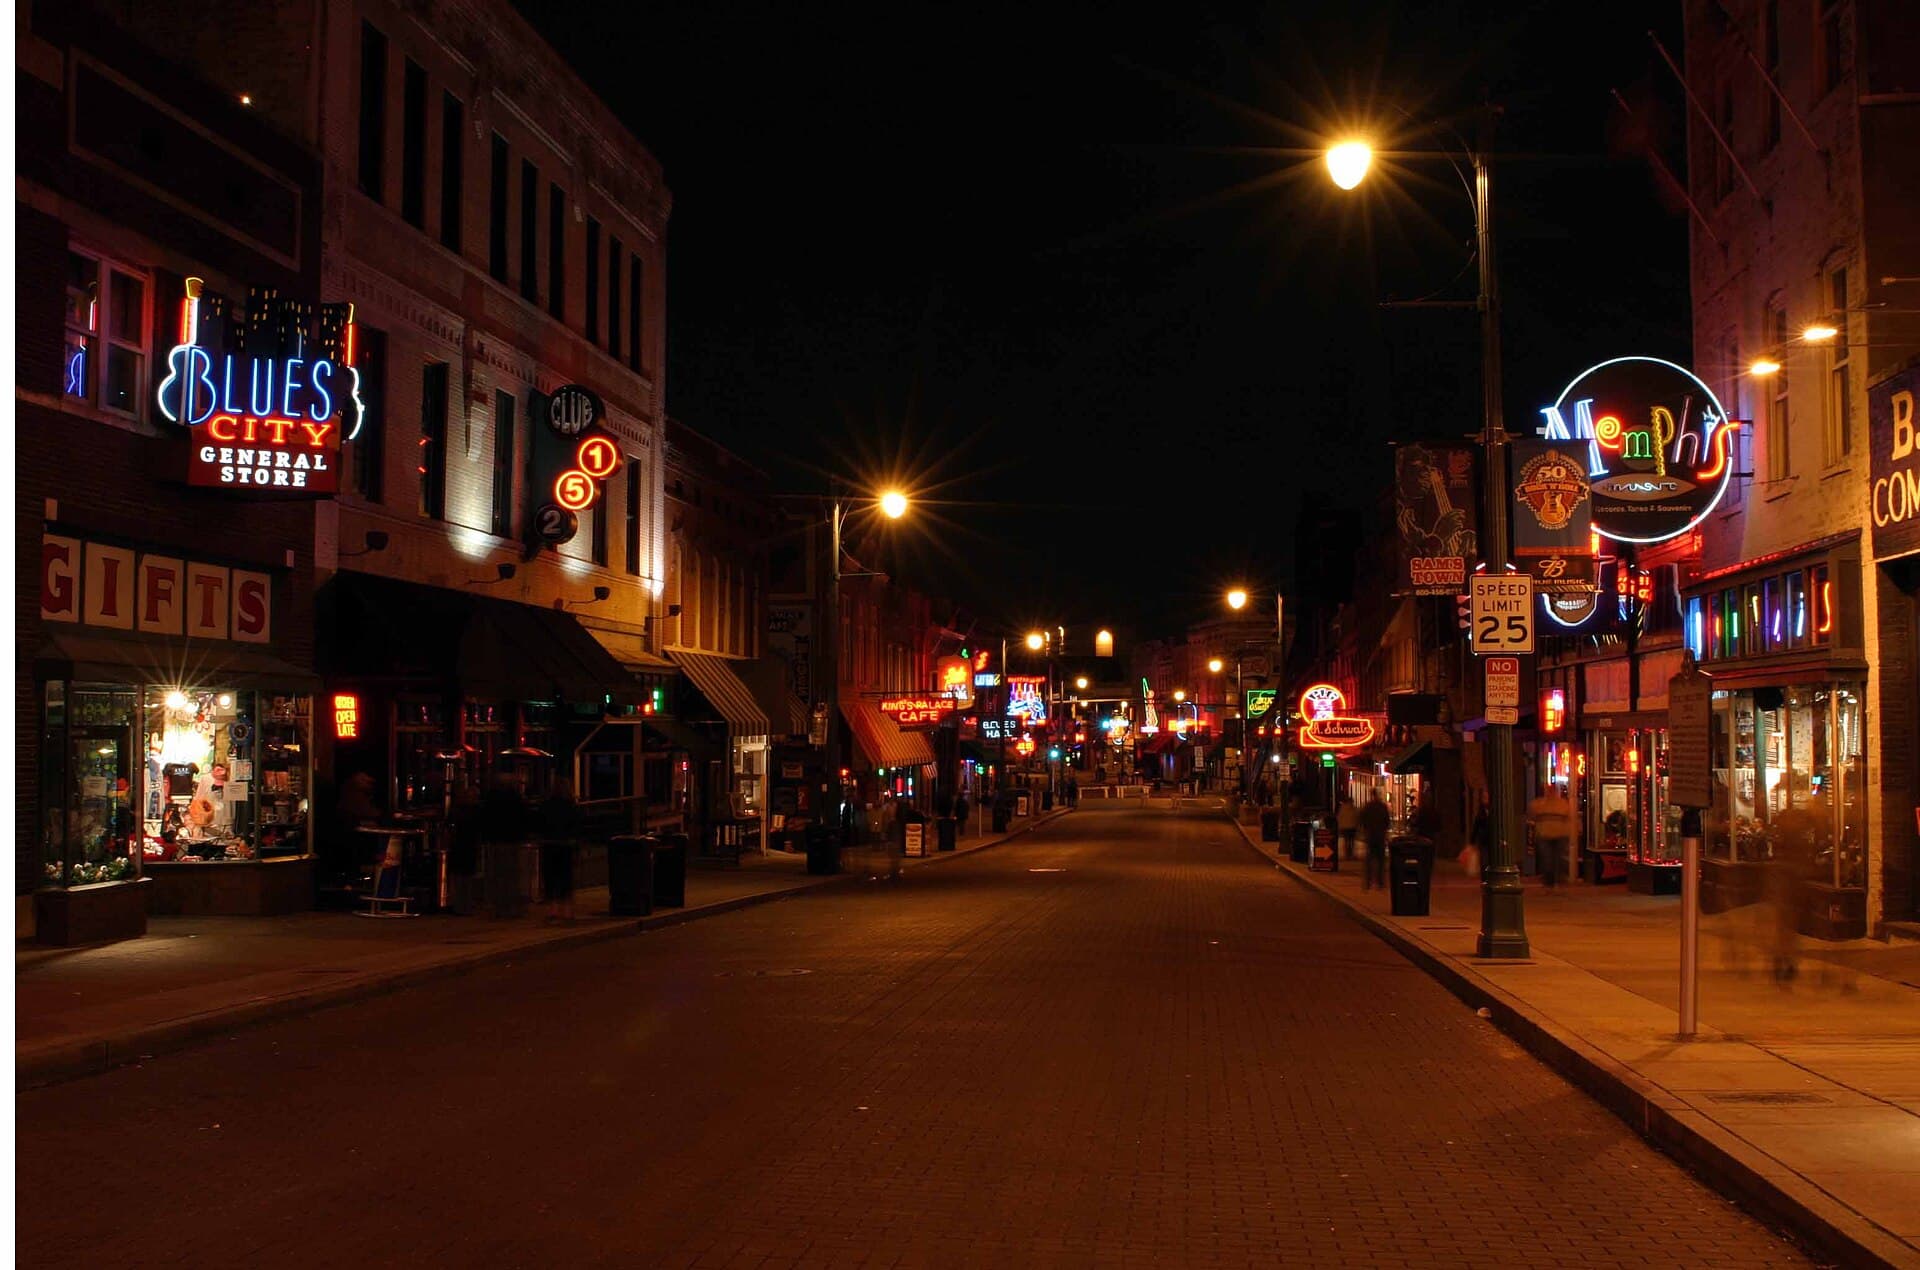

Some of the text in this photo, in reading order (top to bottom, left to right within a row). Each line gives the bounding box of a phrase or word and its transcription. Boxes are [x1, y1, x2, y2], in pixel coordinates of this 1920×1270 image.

[188, 346, 333, 425] BLUES
[551, 391, 594, 435] CLUB
[207, 415, 333, 446] CITY
[199, 446, 328, 471] GENERAL
[588, 444, 602, 470] 1
[220, 467, 307, 488] STORE
[1537, 465, 1567, 480] 50
[564, 478, 585, 503] 5
[543, 510, 562, 535] 2
[41, 542, 267, 636] GIFTS
[1411, 571, 1466, 585] TOWN
[1476, 584, 1527, 596] SPEED
[1482, 600, 1522, 612] LIMIT
[1478, 615, 1528, 644] 25
[1491, 662, 1512, 672] NO
[335, 710, 357, 724] OPEN
[899, 710, 939, 722] CAFE
[337, 723, 357, 736] LATE
